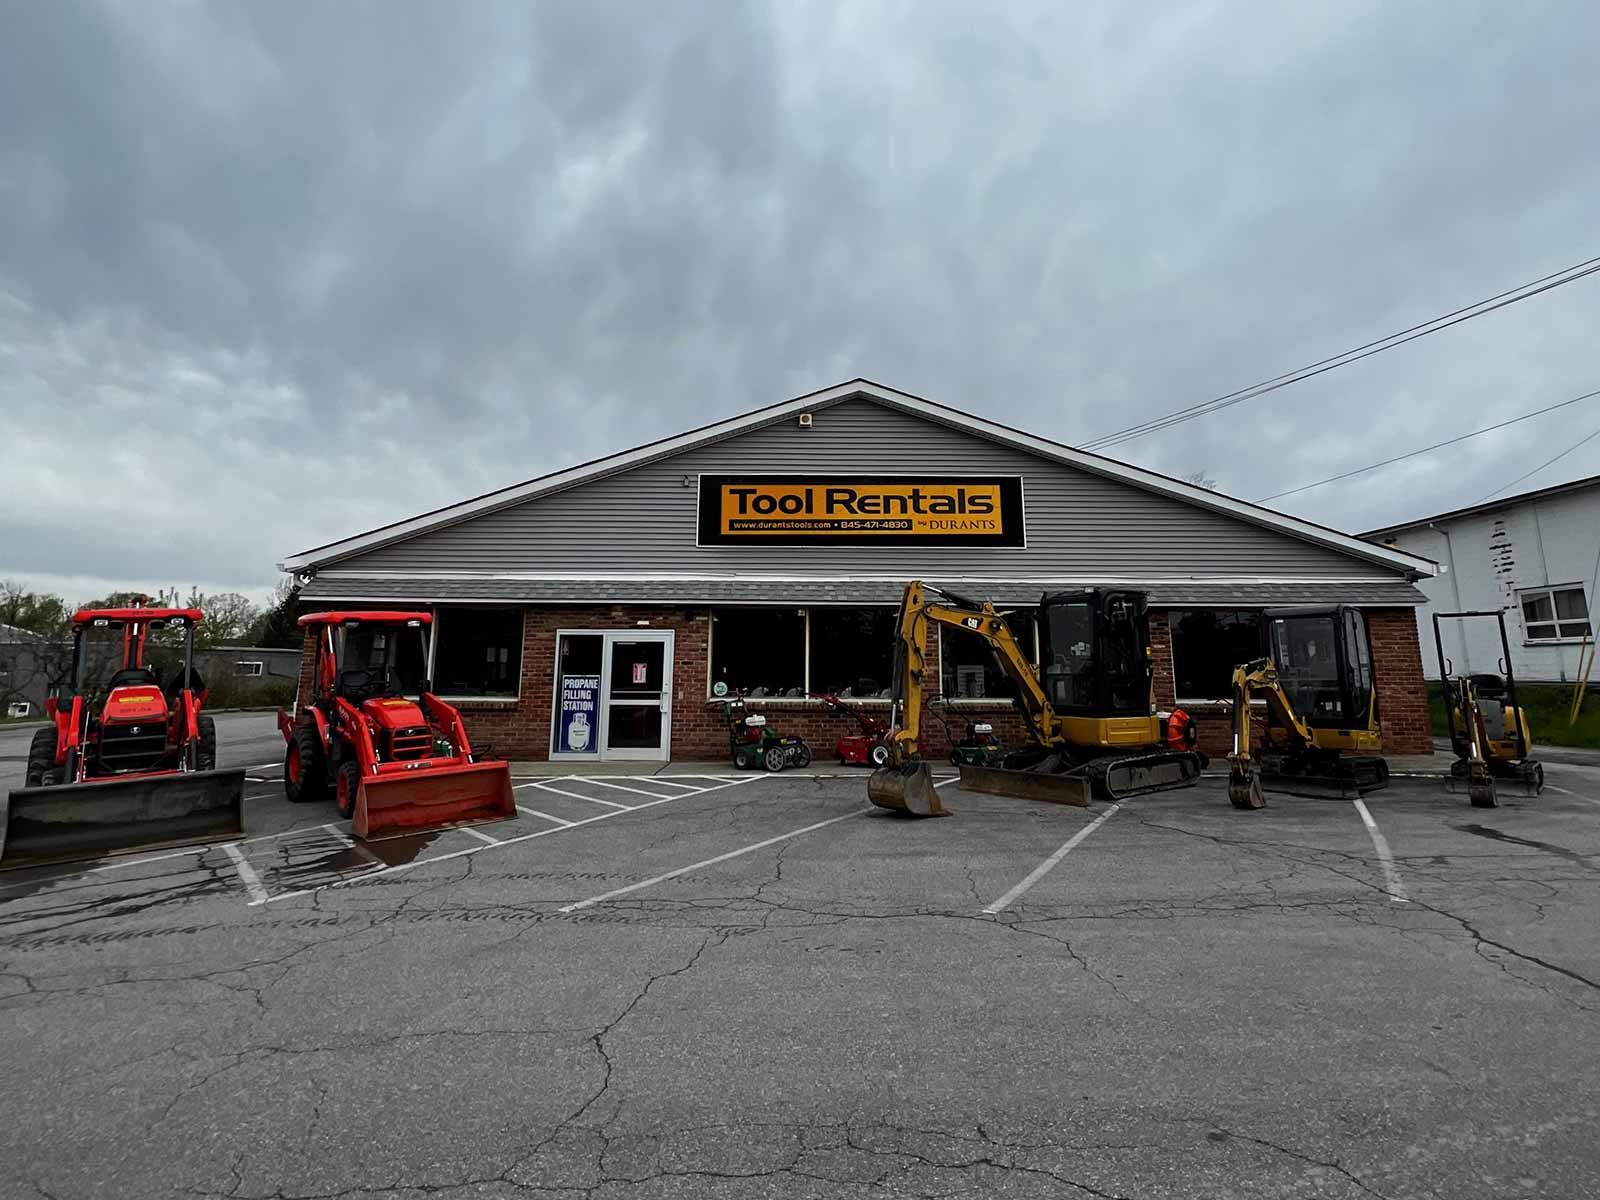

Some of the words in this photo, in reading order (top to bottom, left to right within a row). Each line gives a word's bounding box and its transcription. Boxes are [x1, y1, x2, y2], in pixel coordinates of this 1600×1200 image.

[729, 488, 813, 515] Tool
[825, 488, 994, 515] Rentals
[733, 521, 831, 529] www.durantstools.com
[840, 521, 908, 529] 845-471-4830
[929, 519, 996, 530] DURANTS
[564, 678, 598, 689] PROPANE
[563, 689, 592, 700] FILLING
[563, 700, 594, 711] STATION
